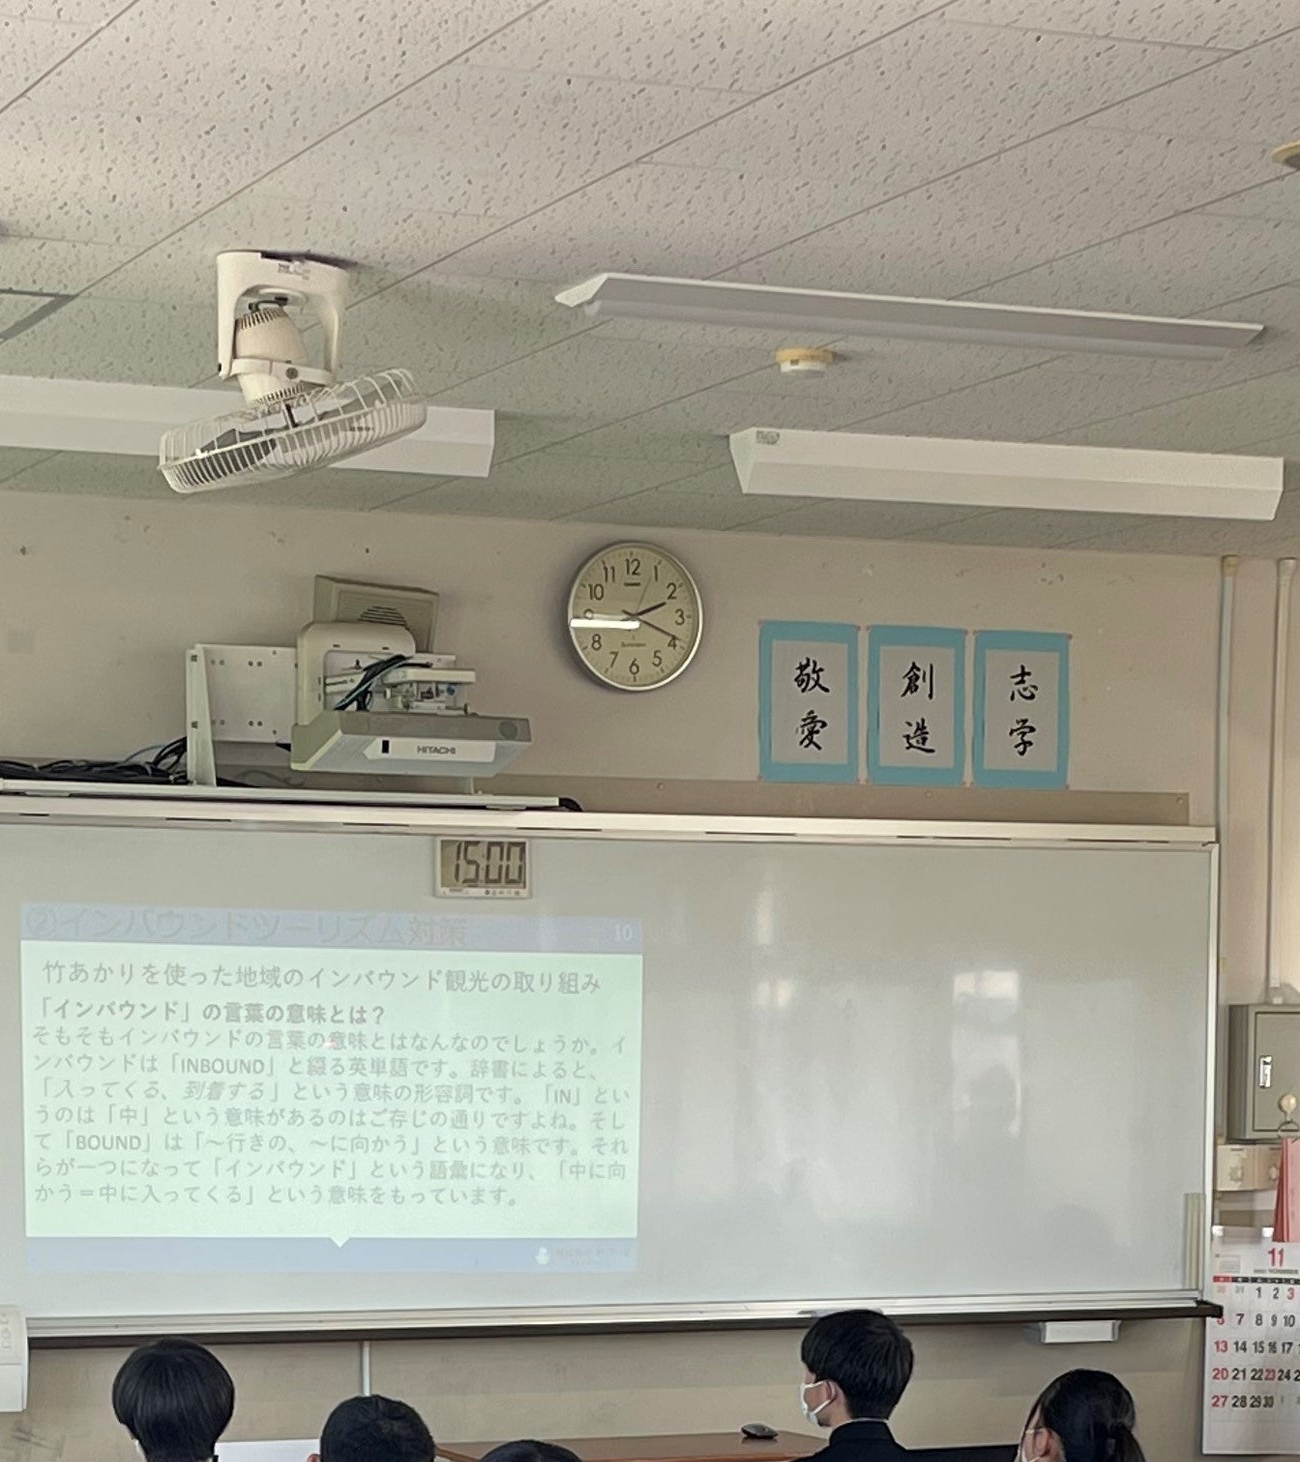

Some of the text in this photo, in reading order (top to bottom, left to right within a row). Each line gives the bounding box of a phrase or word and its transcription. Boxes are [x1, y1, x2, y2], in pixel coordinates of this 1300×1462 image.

[603, 566, 615, 583] 11
[625, 558, 641, 576] 12
[653, 565, 659, 582] 1
[588, 583, 604, 601] 10
[666, 582, 677, 600] 2
[675, 608, 685, 626] 3
[591, 634, 602, 651] 8
[667, 635, 678, 650] 4
[609, 651, 619, 668] 7
[629, 658, 640, 675] 6
[652, 650, 662, 667] 5
[793, 657, 830, 751] 敬愛
[900, 661, 935, 754] 創造
[1008, 665, 1039, 757] 志学
[417, 745, 457, 755] HITACHI
[613, 923, 633, 943] 10
[1268, 1247, 1284, 1267] 11
[1256, 1287, 1262, 1298] 1
[1272, 1287, 1280, 1300] 2
[1286, 1287, 1295, 1300] 3
[1236, 1313, 1245, 1325] 7
[1255, 1313, 1263, 1326] 8
[1271, 1314, 1278, 1327] 9
[1283, 1314, 1296, 1328] 10
[1214, 1340, 1228, 1353] 13
[1233, 1340, 1247, 1353] 14
[1252, 1341, 1265, 1354] 15
[1268, 1341, 1277, 1354] 16
[1281, 1341, 1294, 1354] 17
[1212, 1368, 1229, 1380] 20
[1232, 1368, 1247, 1381] 21
[1250, 1368, 1263, 1381] 22
[1264, 1368, 1276, 1381] 23
[1277, 1368, 1291, 1381] 24
[1211, 1395, 1228, 1407] 27
[1231, 1395, 1247, 1408] 28
[1249, 1395, 1261, 1408] 29
